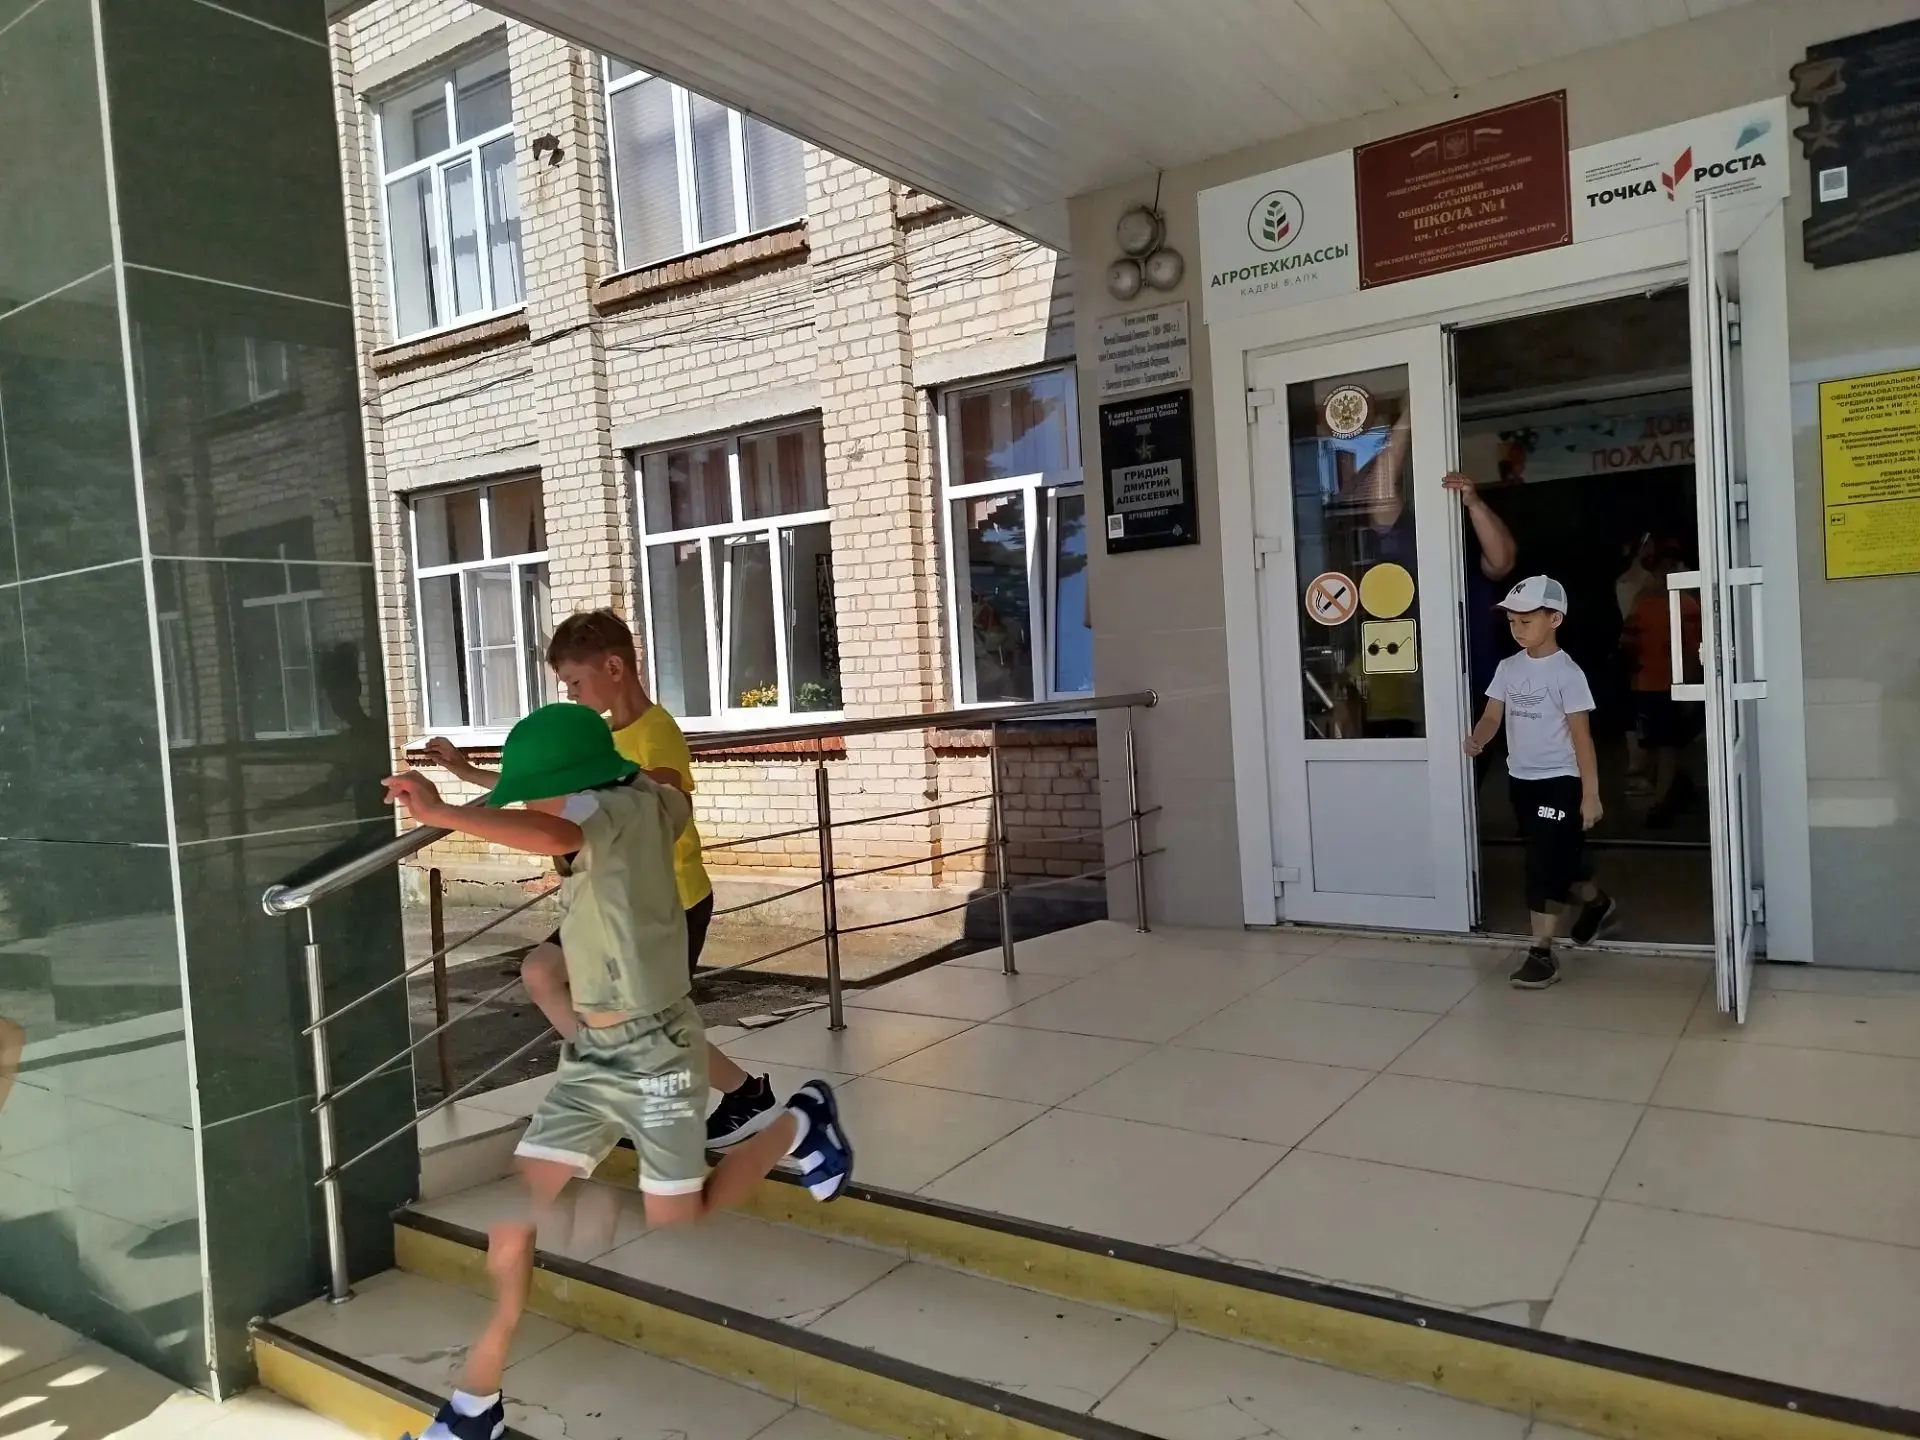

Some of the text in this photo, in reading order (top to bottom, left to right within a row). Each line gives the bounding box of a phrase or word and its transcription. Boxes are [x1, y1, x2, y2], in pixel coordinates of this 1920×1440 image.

[1586, 153, 1766, 207] ТОЧКА РОСТА
[1413, 206, 1473, 230] ШКОЛА
[1210, 243, 1349, 288] АГРОТЕХКЛАССЫ
[1240, 281, 1279, 296] КАДРЫ
[1294, 271, 1319, 283] АПК
[1849, 406, 1875, 414] ШКОЛА
[1124, 466, 1168, 481] ГРИДИН
[1123, 477, 1171, 493] ДМИТРИЙ
[1117, 488, 1180, 505] АЛЕКСЕЕВИЧ
